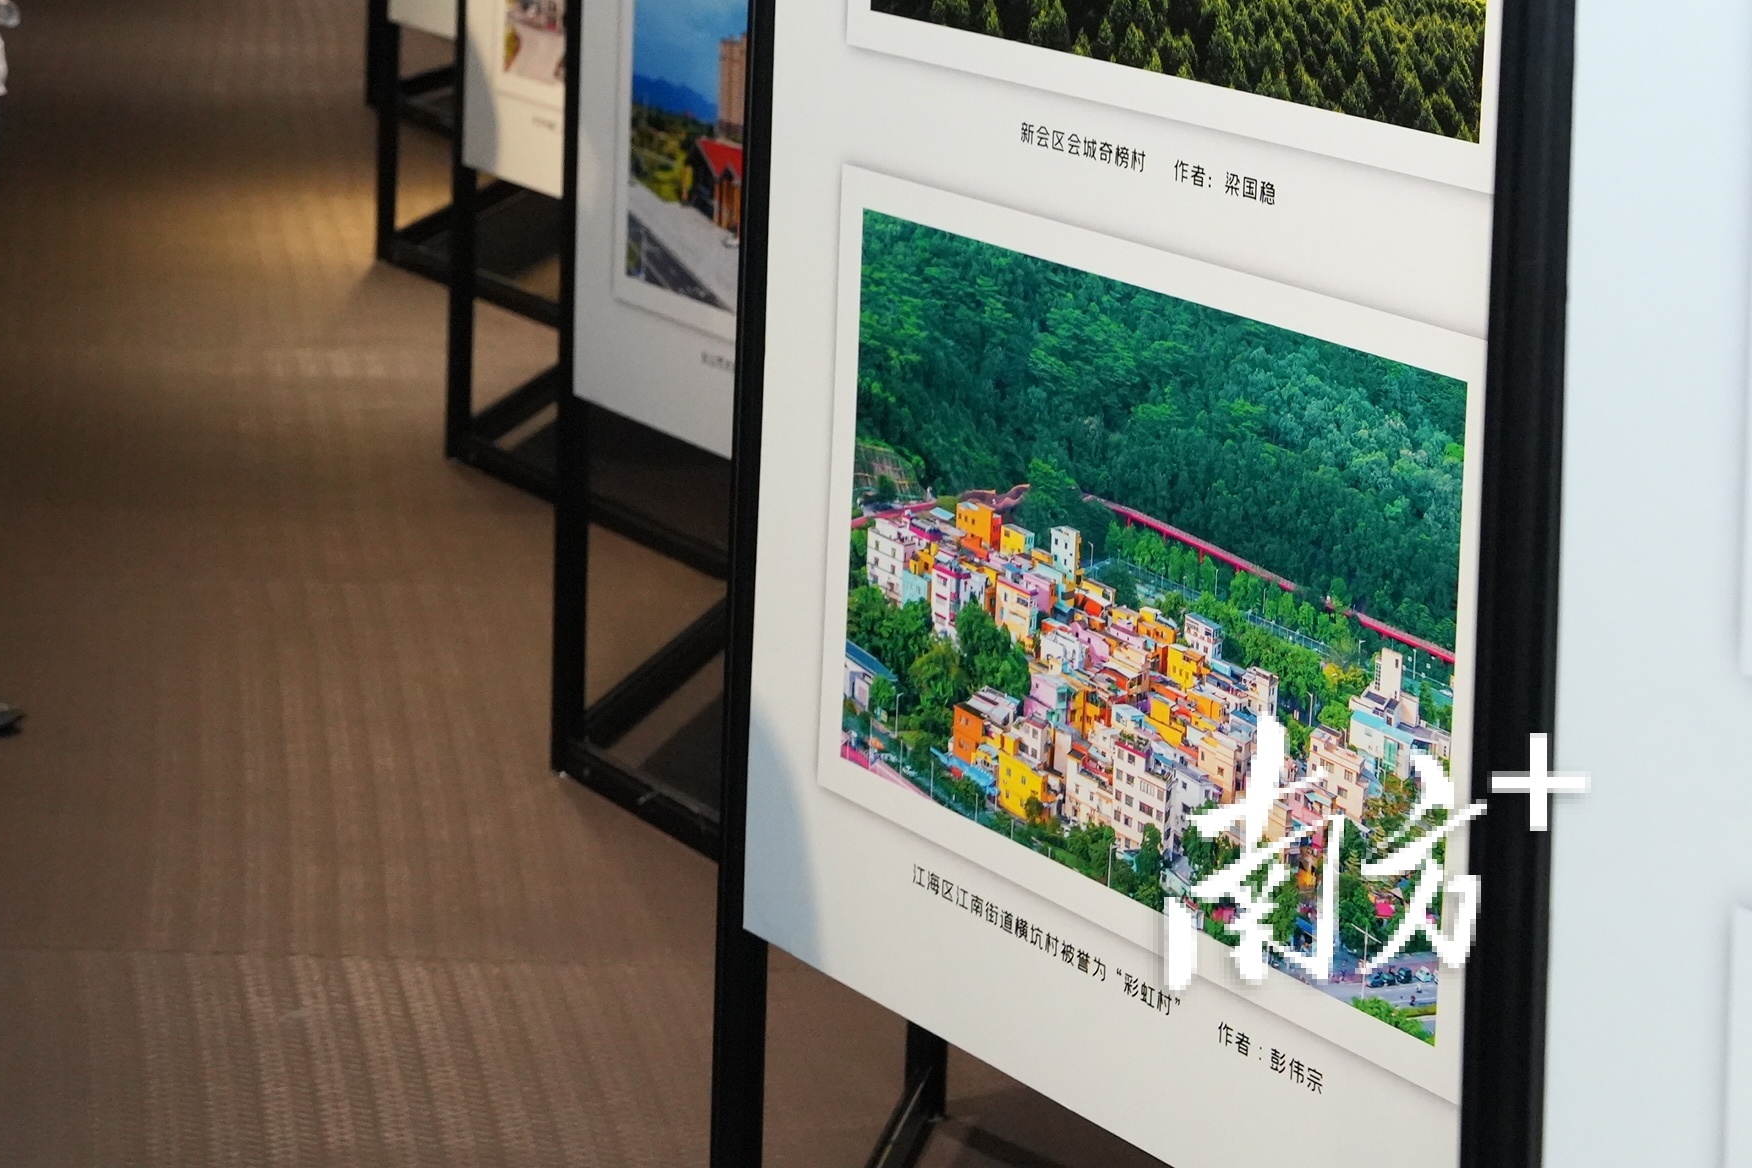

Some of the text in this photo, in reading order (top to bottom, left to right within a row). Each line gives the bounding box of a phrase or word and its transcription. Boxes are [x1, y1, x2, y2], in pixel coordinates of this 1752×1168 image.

[1020, 122, 1146, 173] 新会区会城奇榜村
